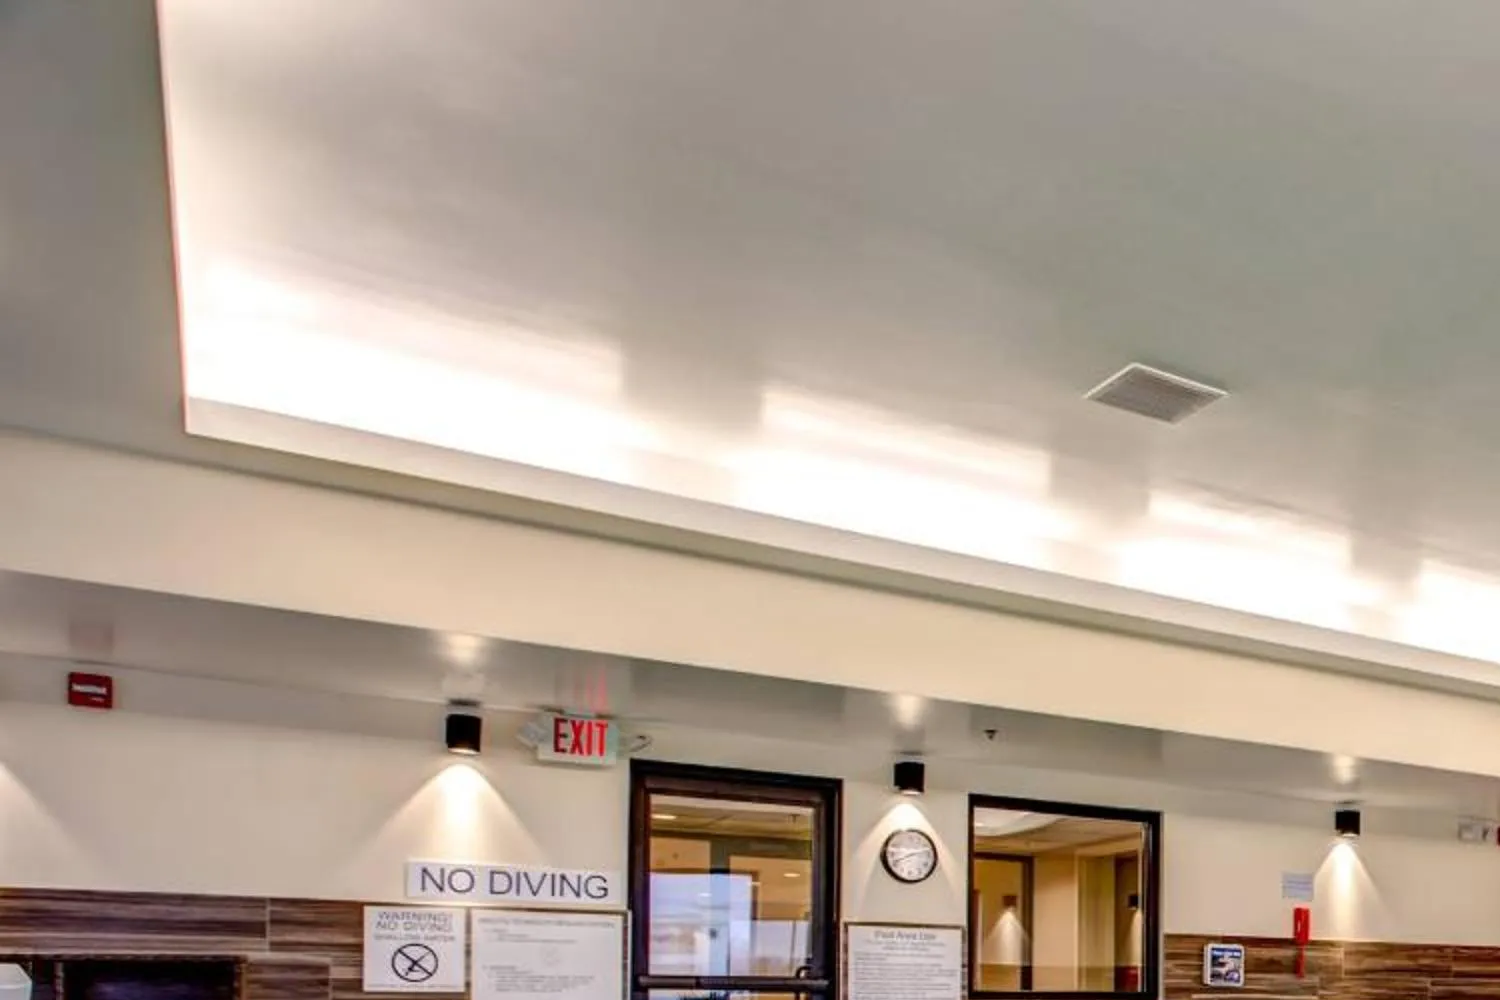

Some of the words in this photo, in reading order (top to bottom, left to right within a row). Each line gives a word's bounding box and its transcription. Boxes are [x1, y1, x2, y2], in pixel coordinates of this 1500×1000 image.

[553, 716, 608, 756] EXIT
[420, 866, 475, 894] NO
[488, 869, 610, 900] DIVING
[374, 921, 399, 931] NO
